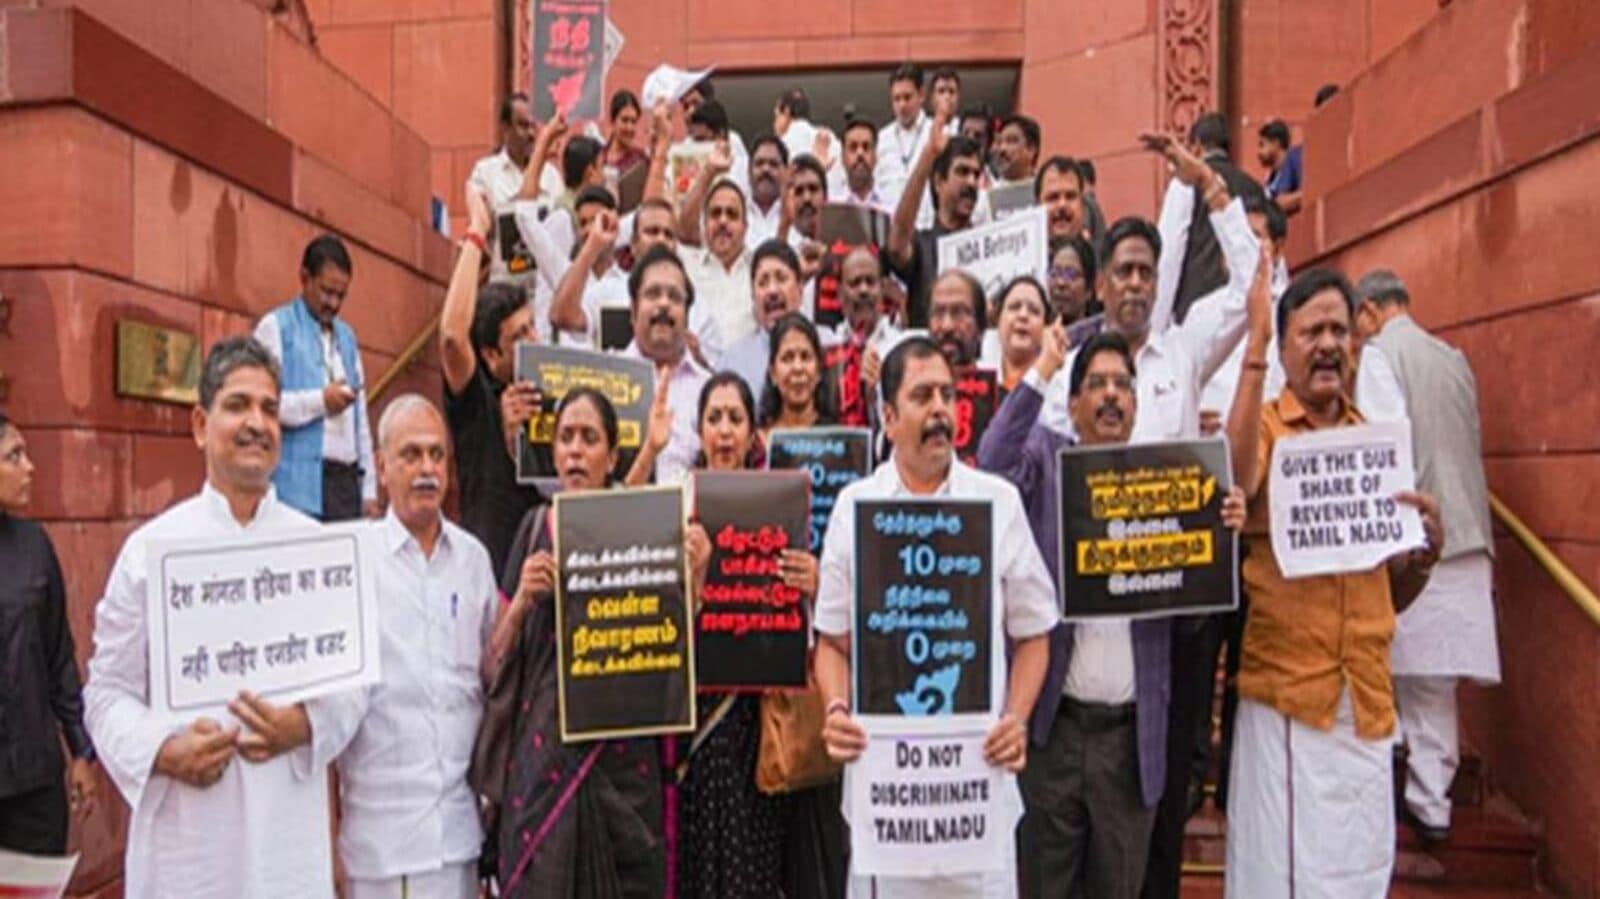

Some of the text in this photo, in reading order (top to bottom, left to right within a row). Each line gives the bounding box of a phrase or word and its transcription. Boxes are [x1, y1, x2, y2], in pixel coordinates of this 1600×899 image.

[1282, 449, 1397, 478] GIVE THE DUE
[1300, 474, 1381, 499] SHARE OF
[1291, 498, 1396, 525] REVENUE TO
[1288, 521, 1403, 549] TAMIL NADU
[898, 545, 935, 576] 10
[171, 564, 353, 609] देश मांगता इंडिया का बजट
[587, 591, 660, 620] வெள்ள
[572, 617, 678, 654] நிவாரணம்
[906, 630, 930, 664] 0
[217, 642, 257, 675] चाहिए
[264, 633, 308, 667] एनडीए
[316, 631, 346, 656] बजट
[871, 779, 989, 806] DISCRIMINATE
[874, 814, 986, 844] TAMILNADU
